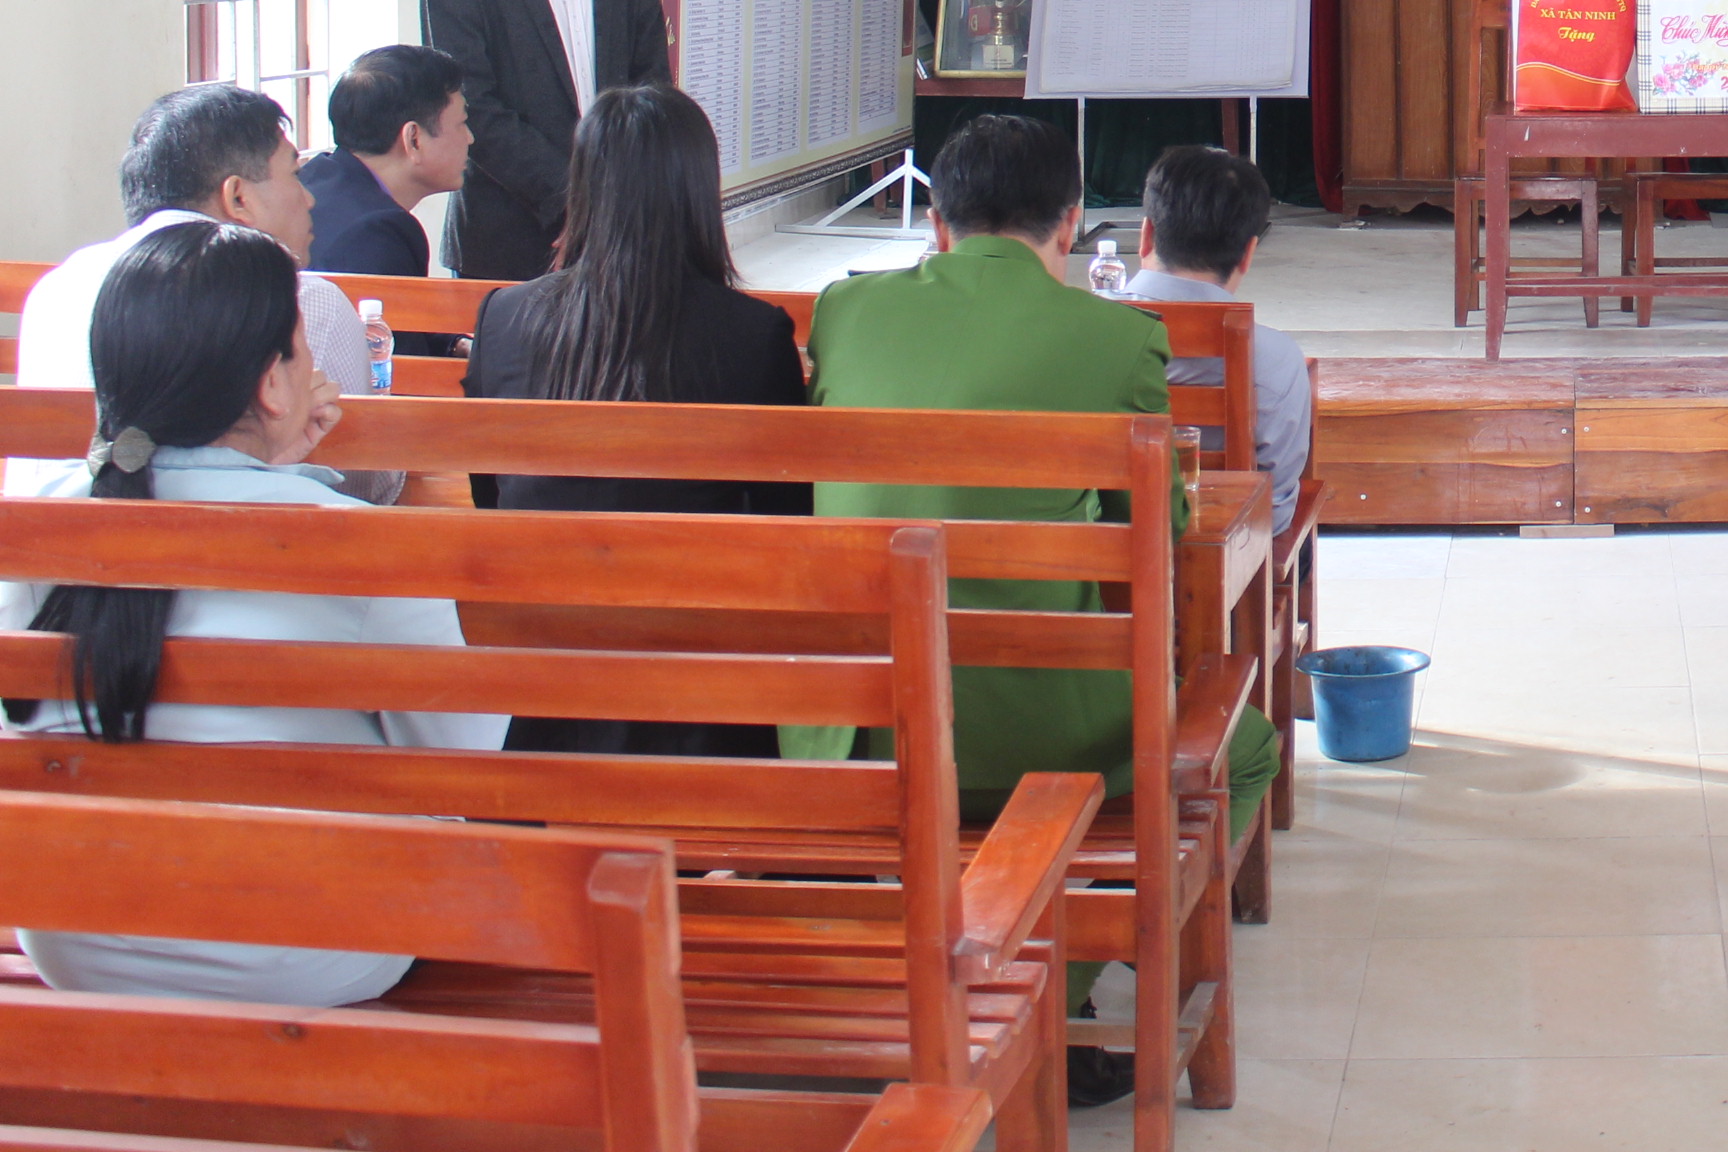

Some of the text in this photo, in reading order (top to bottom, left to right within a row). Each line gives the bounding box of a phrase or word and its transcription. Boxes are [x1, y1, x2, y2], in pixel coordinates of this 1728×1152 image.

[1540, 8, 1616, 20] XÃ TÂN NINH
[1558, 26, 1596, 43] Tặng
[1660, 15, 1700, 44] Chúc
